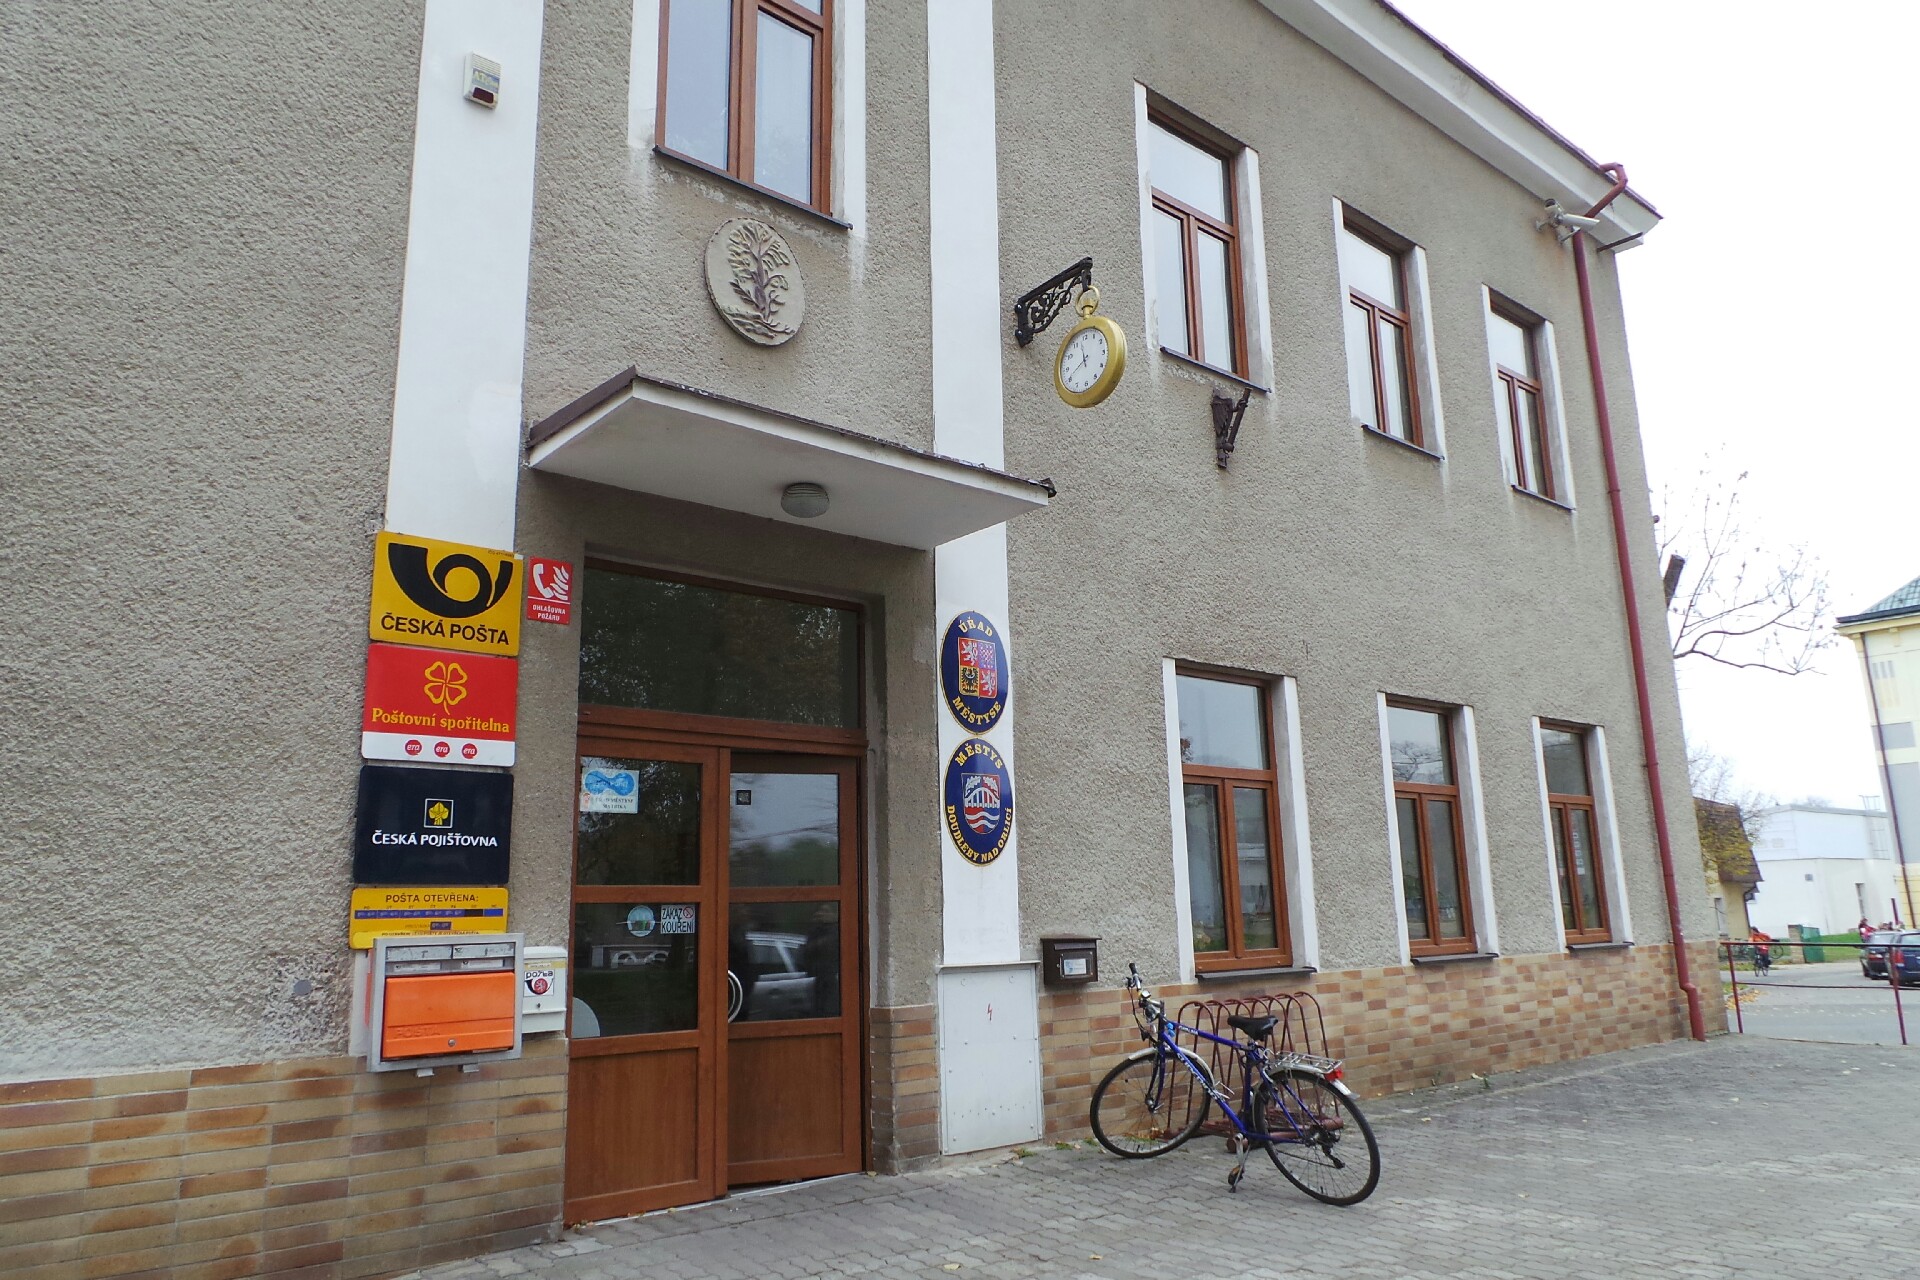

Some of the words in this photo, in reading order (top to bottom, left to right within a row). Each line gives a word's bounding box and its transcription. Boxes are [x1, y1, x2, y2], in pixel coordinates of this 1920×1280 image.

[532, 604, 566, 615] OHLAŠOVNA
[537, 612, 560, 621] POŽÁRU
[380, 612, 446, 638] ČESKÁ
[450, 622, 510, 646] POŠTA
[958, 616, 993, 637] ÚŘAD
[371, 707, 437, 727] Poštovní
[440, 715, 511, 733] spořitelna
[952, 696, 1002, 725] MĚSTYSE
[406, 743, 420, 751] era
[435, 745, 449, 753] era
[463, 747, 476, 755] era
[954, 742, 1003, 769] MĚSTYS
[372, 829, 418, 845] ČESKÁ
[420, 832, 498, 848] POJIŠŤOVNA
[947, 804, 980, 862] DOUDLEBY
[981, 848, 999, 863] NAD
[997, 807, 1012, 848] ORLICÍ
[385, 892, 420, 903] POŠTA
[423, 891, 479, 903] OTEVŘENA:
[662, 907, 682, 919] ZÁKAZ
